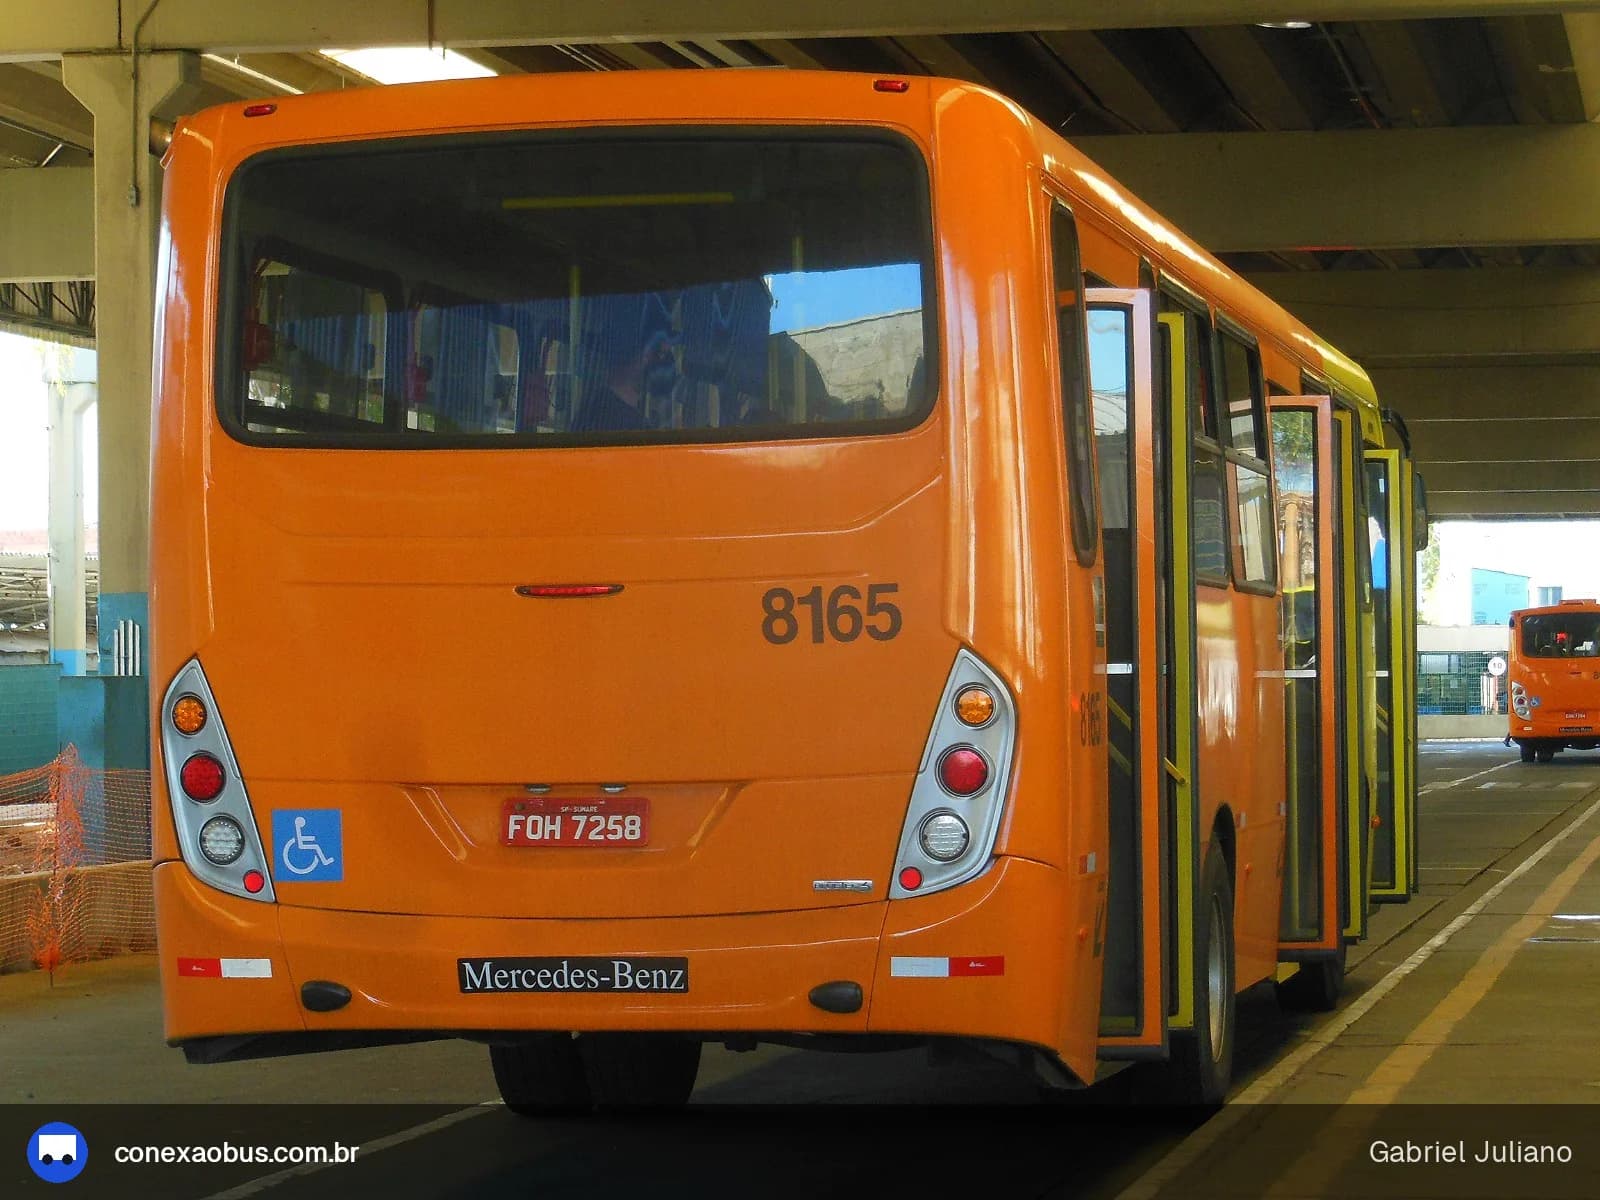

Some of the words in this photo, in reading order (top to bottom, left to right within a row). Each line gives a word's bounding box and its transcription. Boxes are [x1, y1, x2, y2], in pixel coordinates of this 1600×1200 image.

[762, 583, 903, 645] 8165
[508, 815, 561, 840] FOH
[571, 815, 642, 840] 7258
[463, 960, 685, 990] Mercedes-Benz
